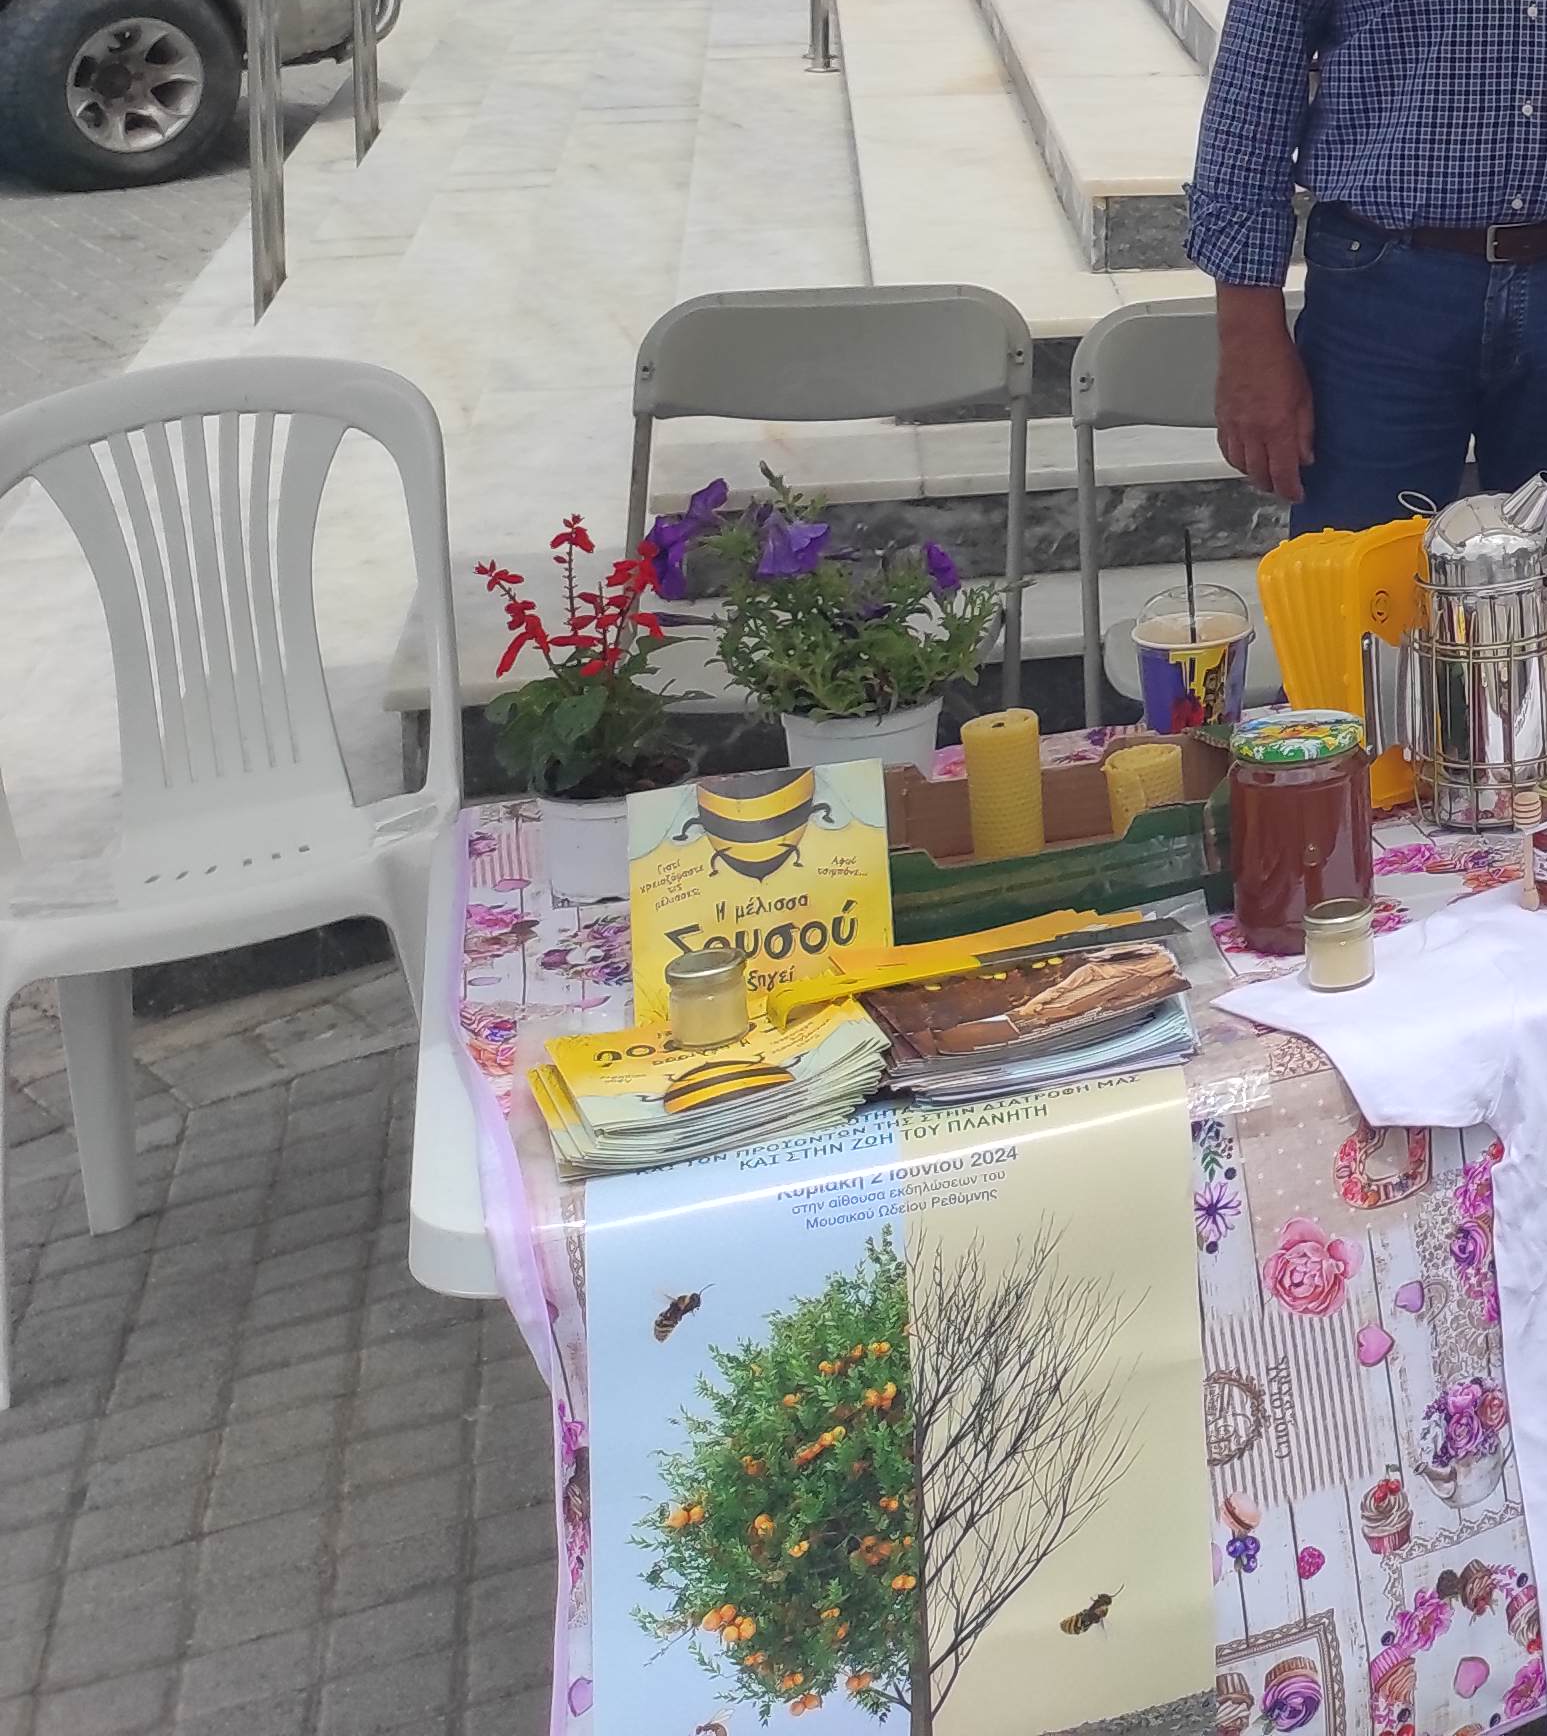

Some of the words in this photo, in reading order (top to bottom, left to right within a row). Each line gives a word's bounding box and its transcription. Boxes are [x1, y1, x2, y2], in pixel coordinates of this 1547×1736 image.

[715, 900, 726, 923] Η
[735, 894, 809, 923] μέλισσα
[747, 965, 796, 992] ξηγεί
[983, 1083, 1090, 1111] ΔΙΑΤΡΟΦΗ
[739, 1155, 780, 1170] ΚΑΙ
[786, 1142, 844, 1162] ΣΤΗΝ
[850, 1132, 894, 1151] ΖΩΗ
[900, 1123, 941, 1142] ΤΟΥ
[947, 1103, 1049, 1134] ΠΛΑΝΗΤΗ
[970, 1145, 1018, 1168] 2024
[792, 1201, 825, 1216] στην
[829, 1190, 886, 1210] αίθουσα
[889, 1175, 978, 1198] εκδηλώσεων
[983, 1169, 1006, 1183] του
[806, 1208, 875, 1230] Μουσικού
[878, 1201, 927, 1218] Ωδείου
[931, 1188, 998, 1210] Ρεθύμνης
